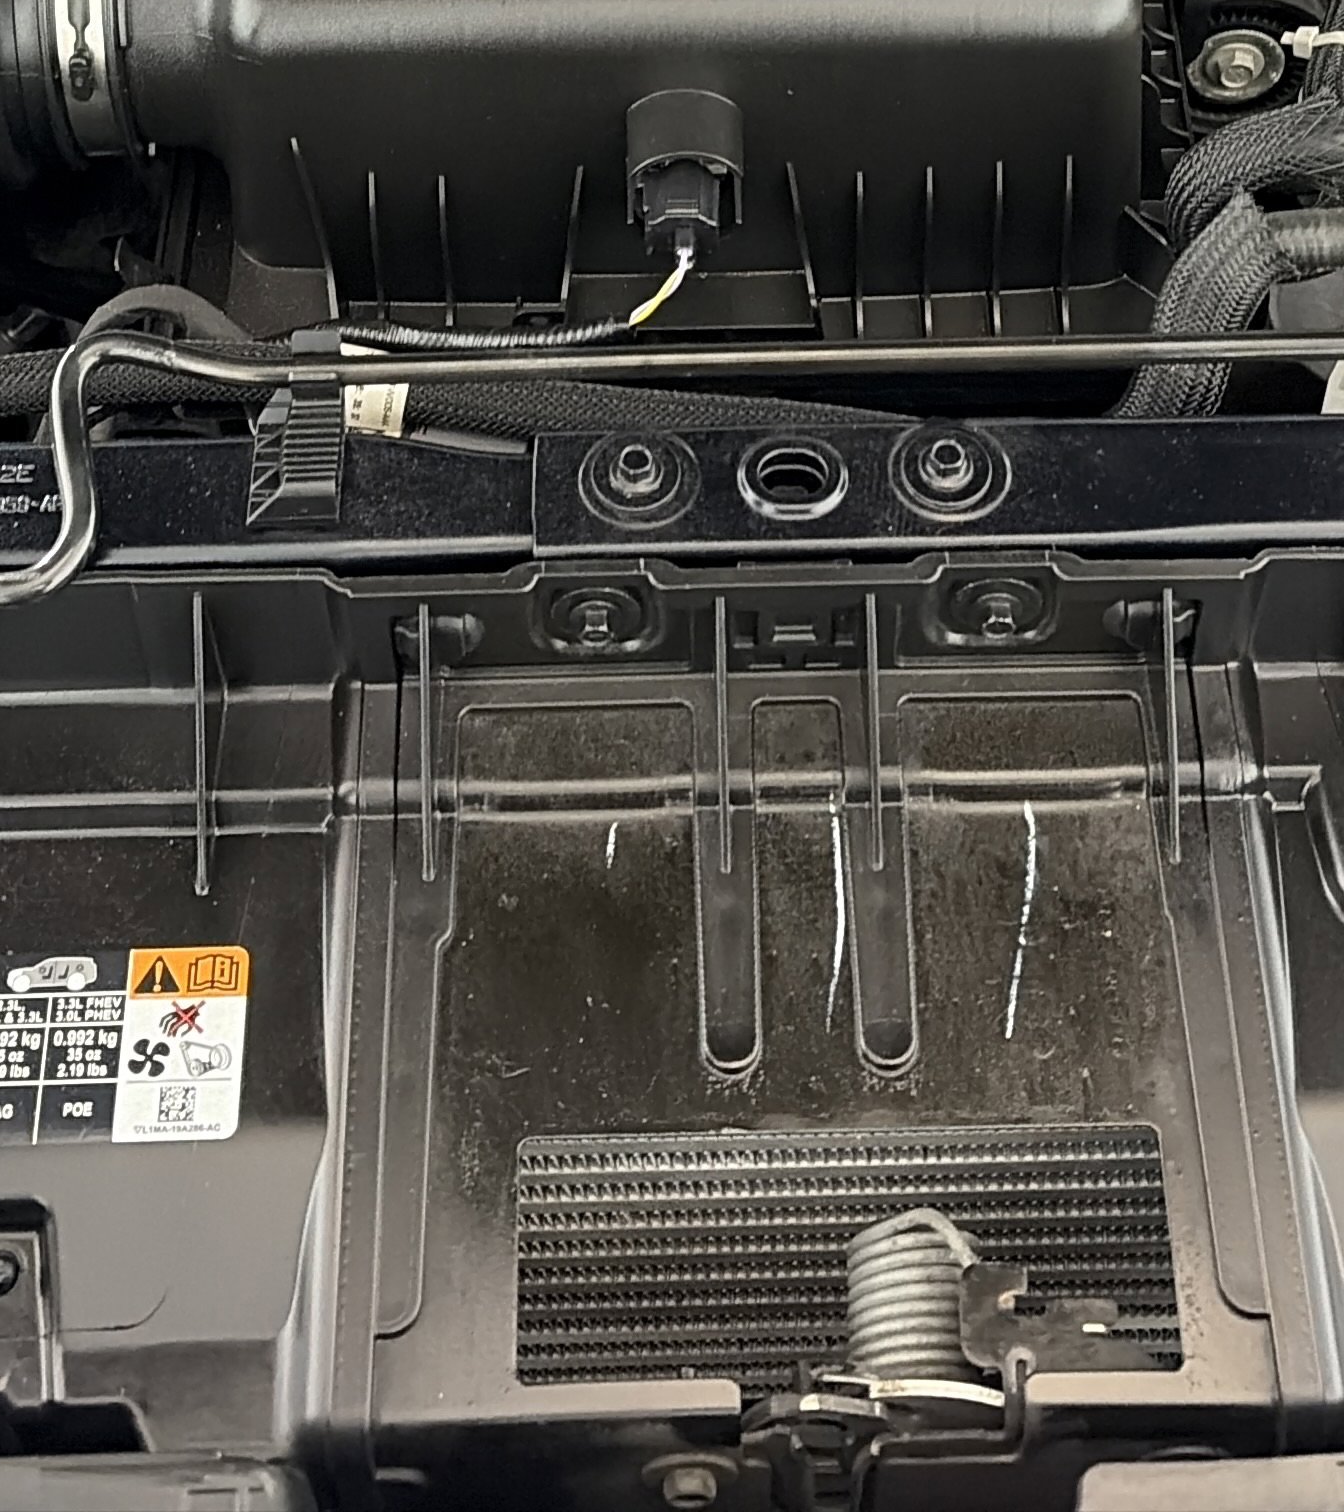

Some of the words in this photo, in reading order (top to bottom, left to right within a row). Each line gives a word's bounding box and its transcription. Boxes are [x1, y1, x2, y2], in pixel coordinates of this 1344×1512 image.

[86, 996, 122, 1009] FHEV
[4, 1012, 14, 1023] &
[85, 1009, 121, 1021] PHEV
[21, 1031, 41, 1050] kg
[53, 1029, 95, 1047] 0.992
[98, 1029, 118, 1048] kg
[8, 1051, 25, 1062] oz
[66, 1048, 83, 1062] 35
[85, 1049, 102, 1061] oz
[10, 1064, 30, 1078] lbs
[57, 1063, 84, 1077] 2.19
[87, 1063, 107, 1076] lbs
[62, 1101, 94, 1117] POE
